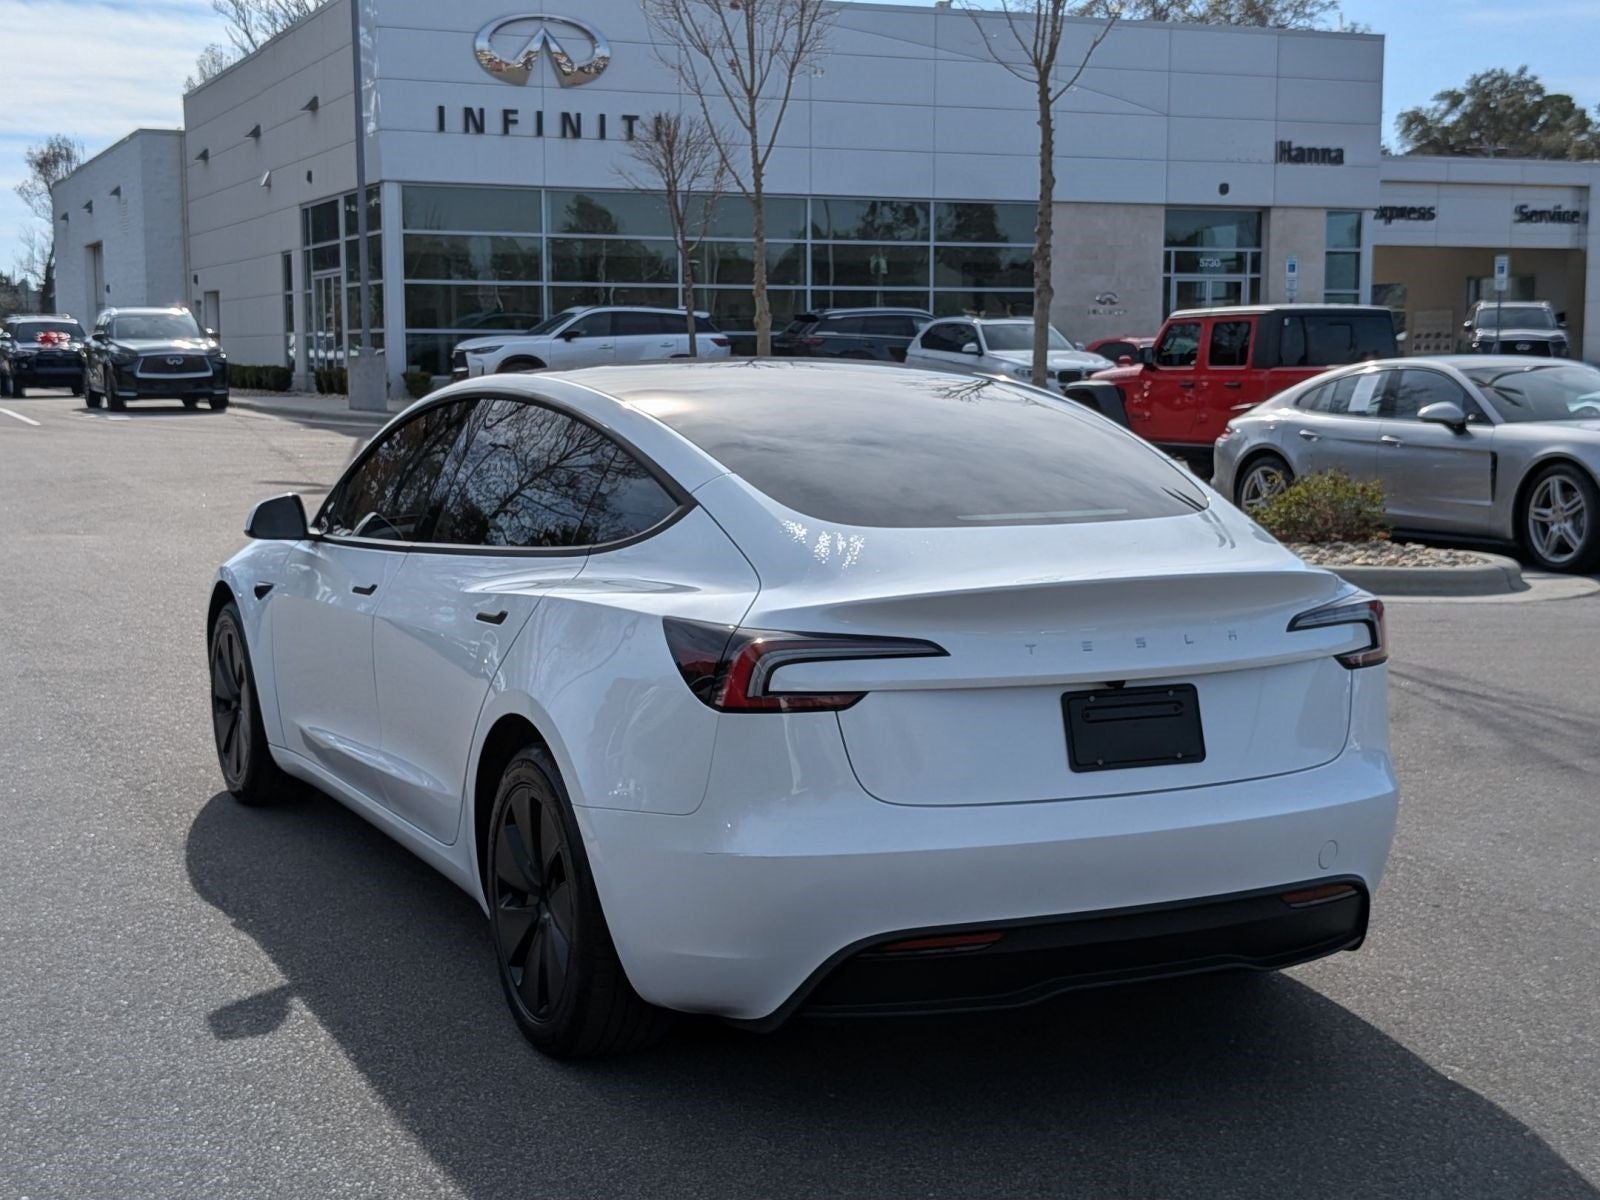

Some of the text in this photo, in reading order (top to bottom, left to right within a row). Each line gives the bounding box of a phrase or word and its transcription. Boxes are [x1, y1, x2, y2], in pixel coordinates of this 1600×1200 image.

[1276, 140, 1344, 165] Hanna
[1374, 204, 1581, 225] xpress Service
[1024, 629, 1238, 655] TESLA
